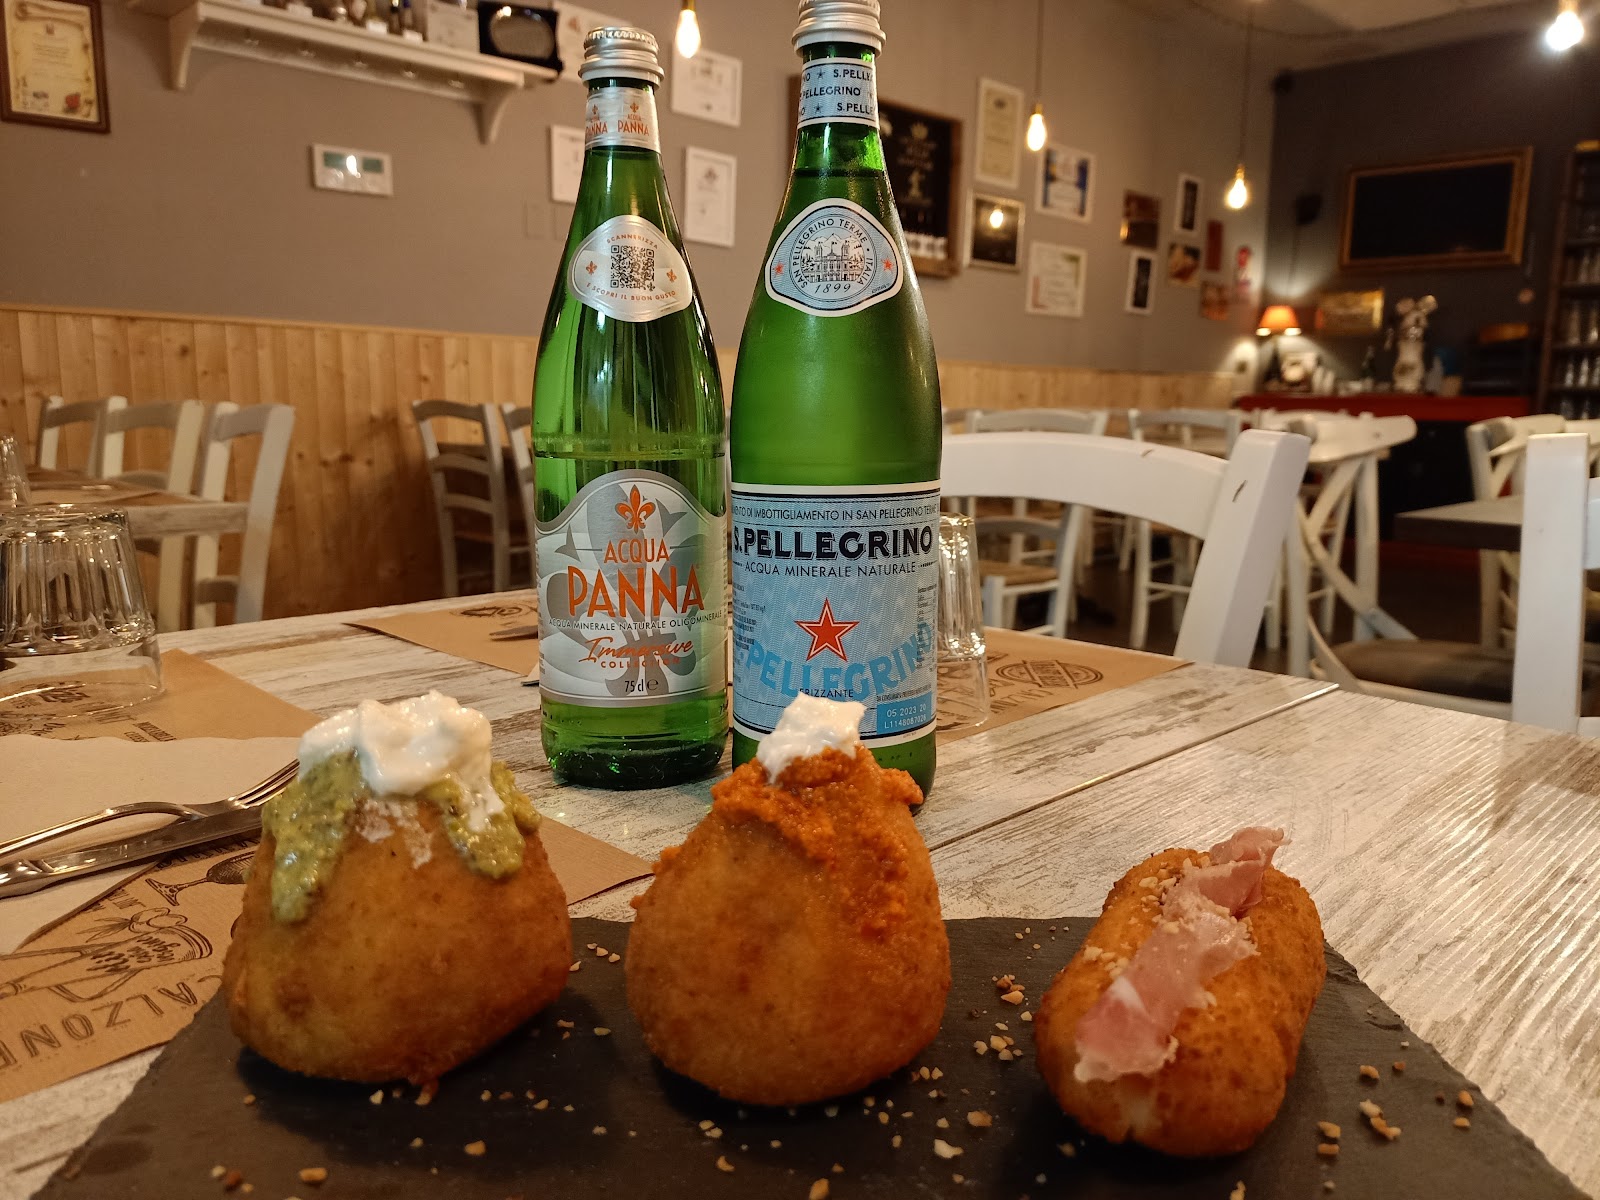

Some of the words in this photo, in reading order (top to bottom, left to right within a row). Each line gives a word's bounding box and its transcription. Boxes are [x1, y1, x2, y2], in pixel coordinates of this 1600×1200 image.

[617, 120, 650, 136] PANNA
[839, 218, 868, 244] TERME
[606, 233, 658, 250] SCANNERIZZA
[792, 218, 835, 267] PELLEGRINO
[793, 270, 808, 289] SAN
[856, 258, 874, 286] ITALIA
[592, 285, 618, 298] SCOPRI
[655, 290, 677, 300] GUSTO
[814, 282, 852, 294] 1899
[754, 508, 840, 521] IMBOTTIGLIAMENTO
[842, 510, 853, 520] IN
[856, 509, 877, 520] SAN
[879, 506, 923, 519] PELLEGRINO
[603, 537, 670, 564] ACQUA
[734, 525, 933, 560] S.PELLEGRINO
[745, 561, 780, 575] ACQUA
[784, 565, 852, 578] MINERALE
[857, 562, 916, 577] NATURALE
[567, 564, 705, 618] PANNA
[549, 617, 573, 630] ACQUA
[573, 620, 616, 631] MINERALE
[619, 621, 666, 631] NATURALE
[669, 610, 723, 628] OLIGOMINERALE
[600, 658, 681, 669] COLLECTION
[886, 708, 897, 718] 05
[899, 705, 917, 717] 2023
